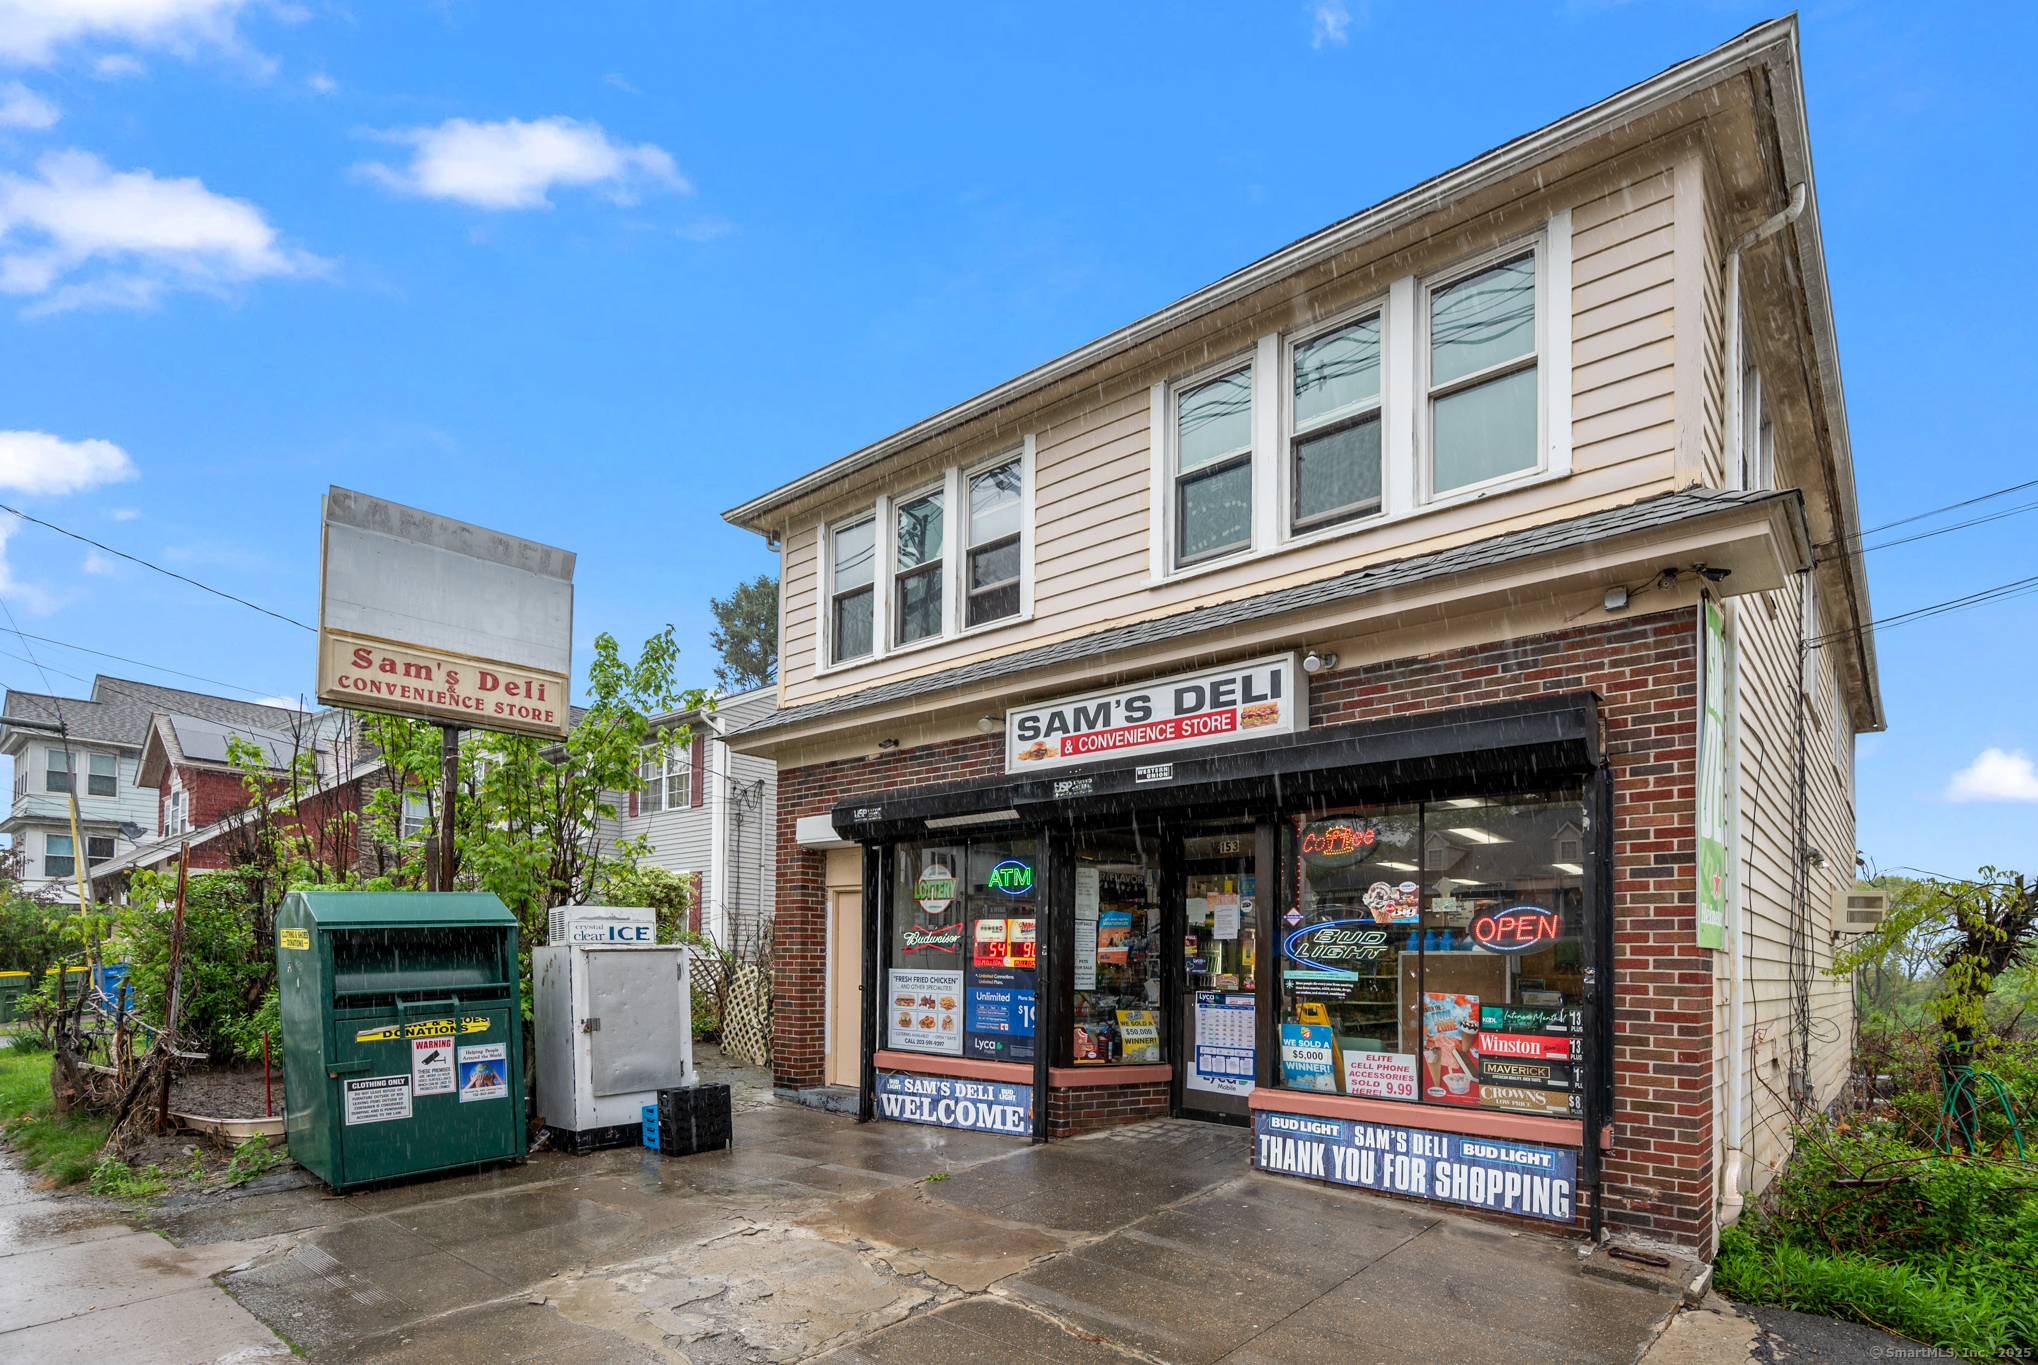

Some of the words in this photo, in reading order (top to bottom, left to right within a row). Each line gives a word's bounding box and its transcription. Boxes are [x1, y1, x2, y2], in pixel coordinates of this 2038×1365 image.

[351, 647, 459, 686] Sam's
[478, 670, 546, 702] Deli
[446, 684, 457, 695] &
[338, 675, 485, 711] CONVENIENCE
[494, 701, 554, 723] STORE
[1017, 694, 1153, 742] SAM'S
[1173, 668, 1282, 717] DELI
[1064, 740, 1073, 755] &
[1078, 724, 1175, 752] CONVENIENCE
[1181, 713, 1232, 736] STORE
[1137, 766, 1169, 776] WESTERN
[1146, 771, 1168, 779] UNION
[1220, 841, 1238, 853] 153
[1302, 828, 1375, 853] Coffee
[988, 866, 1032, 888] ATM
[914, 878, 958, 900] LOTTERY
[1391, 905, 1417, 918] Big
[573, 930, 606, 941] clear
[608, 926, 650, 941] ICE
[1475, 914, 1558, 942] OPEN
[903, 931, 962, 946] Budweiser
[1313, 928, 1387, 945] BUD
[989, 942, 1006, 957] 54
[1294, 943, 1389, 959] LIGHT
[913, 976, 929, 984] FRIED
[976, 991, 1011, 1002] Unlimited
[1199, 993, 1215, 1001] Lyca
[1431, 1009, 1454, 1020] COOL
[1482, 1016, 1497, 1024] KOOL
[1504, 1010, 1532, 1021] Intense
[1532, 1008, 1567, 1023] Menthol
[382, 1024, 469, 1038] DONATIONS
[1125, 1028, 1153, 1036] $50,000
[1434, 1020, 1459, 1033] ZONE
[415, 1039, 452, 1050] WARNING
[974, 1037, 996, 1050] Lyca
[1283, 1038, 1297, 1047] WE
[1298, 1039, 1320, 1048] SOLD
[1323, 1041, 1330, 1049] A
[1480, 1034, 1541, 1055] Winston
[1292, 1049, 1324, 1061] $5,000
[1366, 1054, 1393, 1063] ELITE
[1286, 1061, 1331, 1073] WINNER!
[1350, 1062, 1374, 1070] CELL
[1376, 1063, 1410, 1073] PHONE
[1487, 1064, 1546, 1076] MAVERICK
[1348, 1070, 1415, 1082] ACCESSORIES
[351, 1080, 387, 1090] CLOTHING
[387, 1078, 406, 1086] ONLY
[904, 1078, 950, 1096] SAM'S
[954, 1082, 994, 1101] DELI
[1351, 1079, 1380, 1088] SOLD
[1351, 1087, 1382, 1097] HERE!
[1386, 1082, 1413, 1096] 9.99
[999, 1093, 1017, 1101] LIGHT
[1480, 1086, 1547, 1106] CROWNS
[1511, 1100, 1533, 1108] PRICE
[880, 1093, 1025, 1132] WELCOME
[1271, 1117, 1300, 1132] BUD
[1300, 1120, 1340, 1137] LIGHT
[1354, 1125, 1407, 1153] SAM'S
[1412, 1133, 1449, 1159] DELI
[1463, 1143, 1498, 1159] BUD
[1499, 1147, 1552, 1167] LIGHT
[1259, 1133, 1326, 1178] THANK
[1332, 1145, 1375, 1185] YOU
[1383, 1152, 1427, 1194] FOR
[1435, 1161, 1570, 1219] SHOPPING
